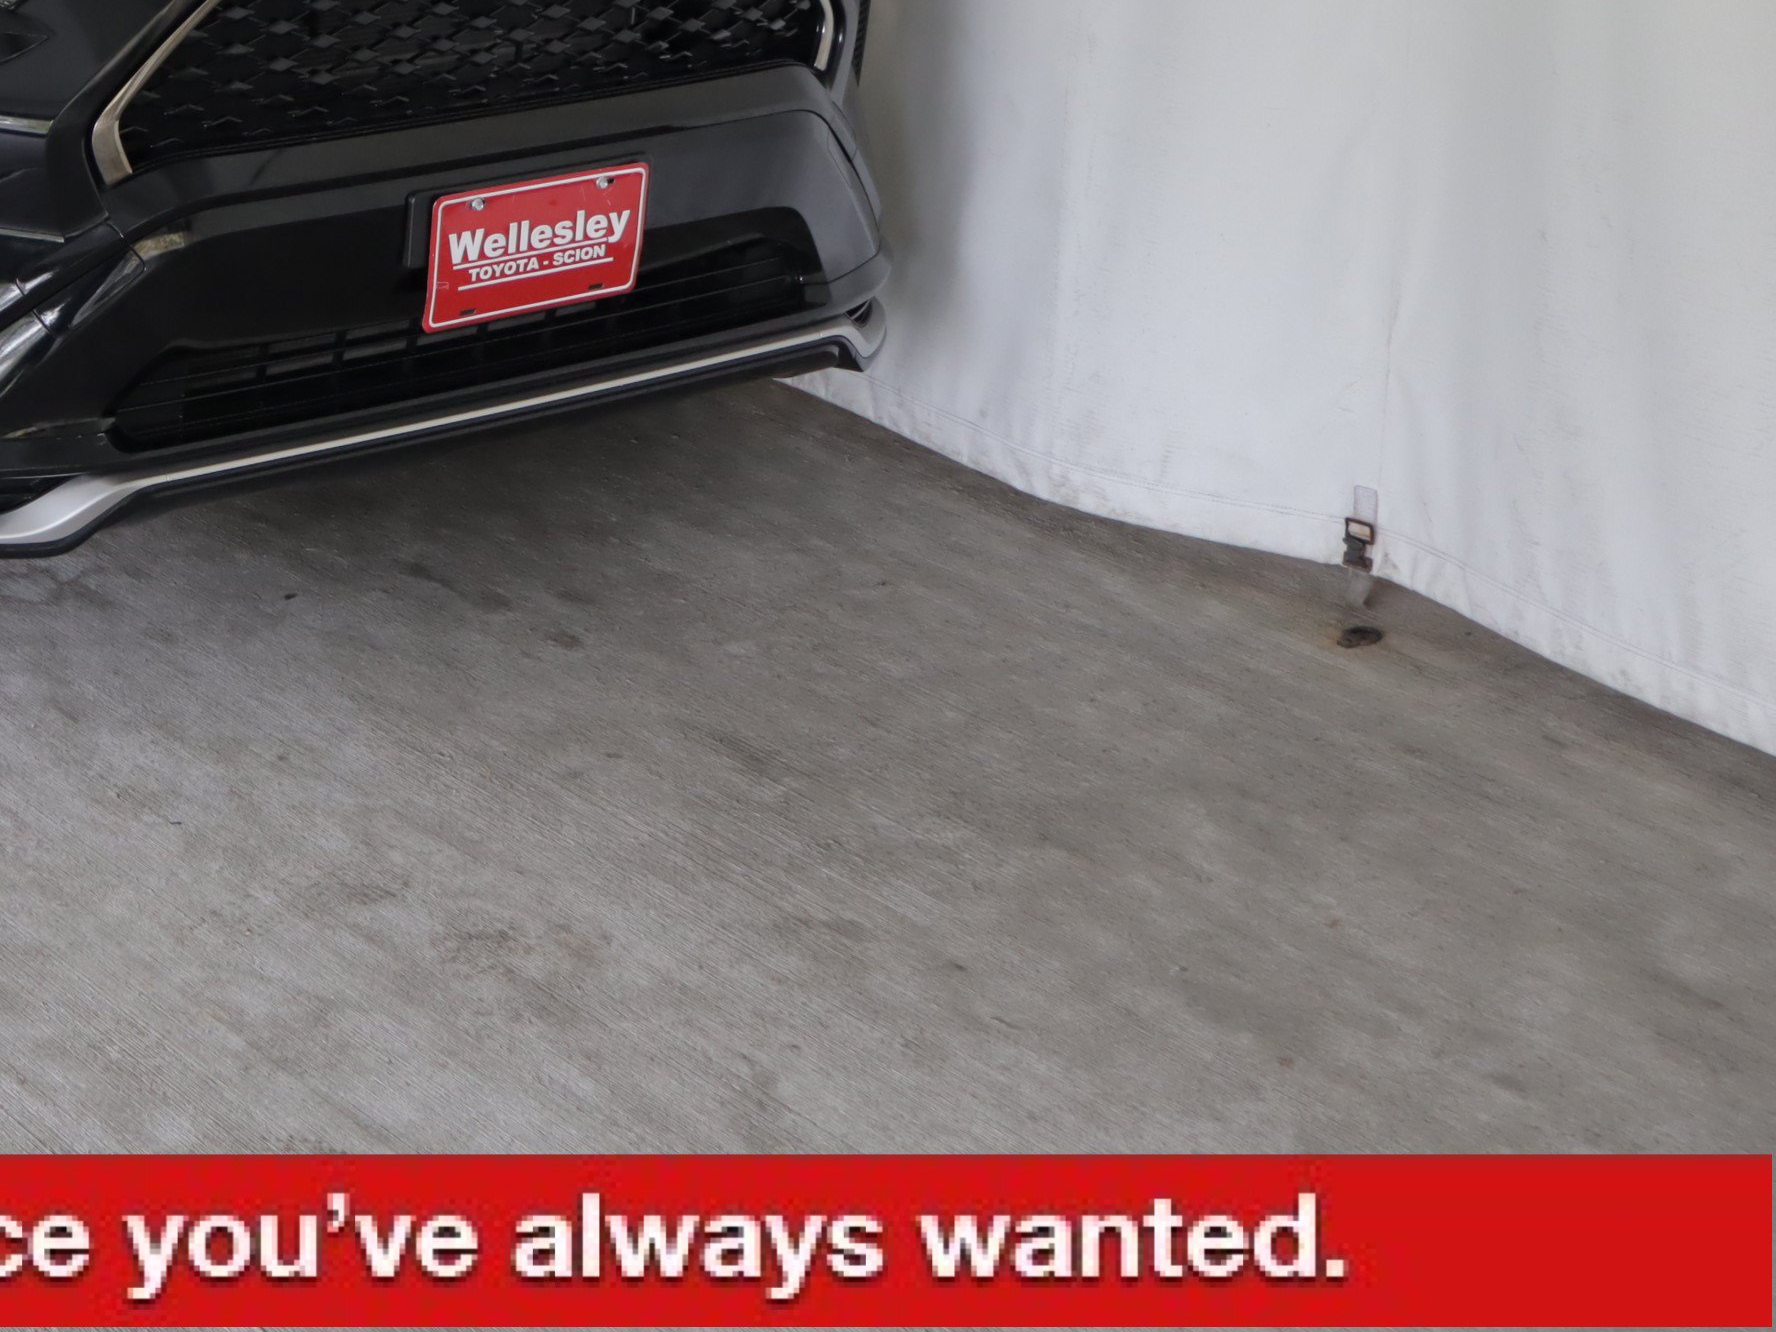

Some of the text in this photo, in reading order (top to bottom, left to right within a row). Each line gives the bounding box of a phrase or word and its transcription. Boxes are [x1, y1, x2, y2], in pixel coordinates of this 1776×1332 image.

[448, 210, 631, 264] Wellesley
[468, 258, 540, 282] TOYOTA
[552, 244, 606, 267] SCION
